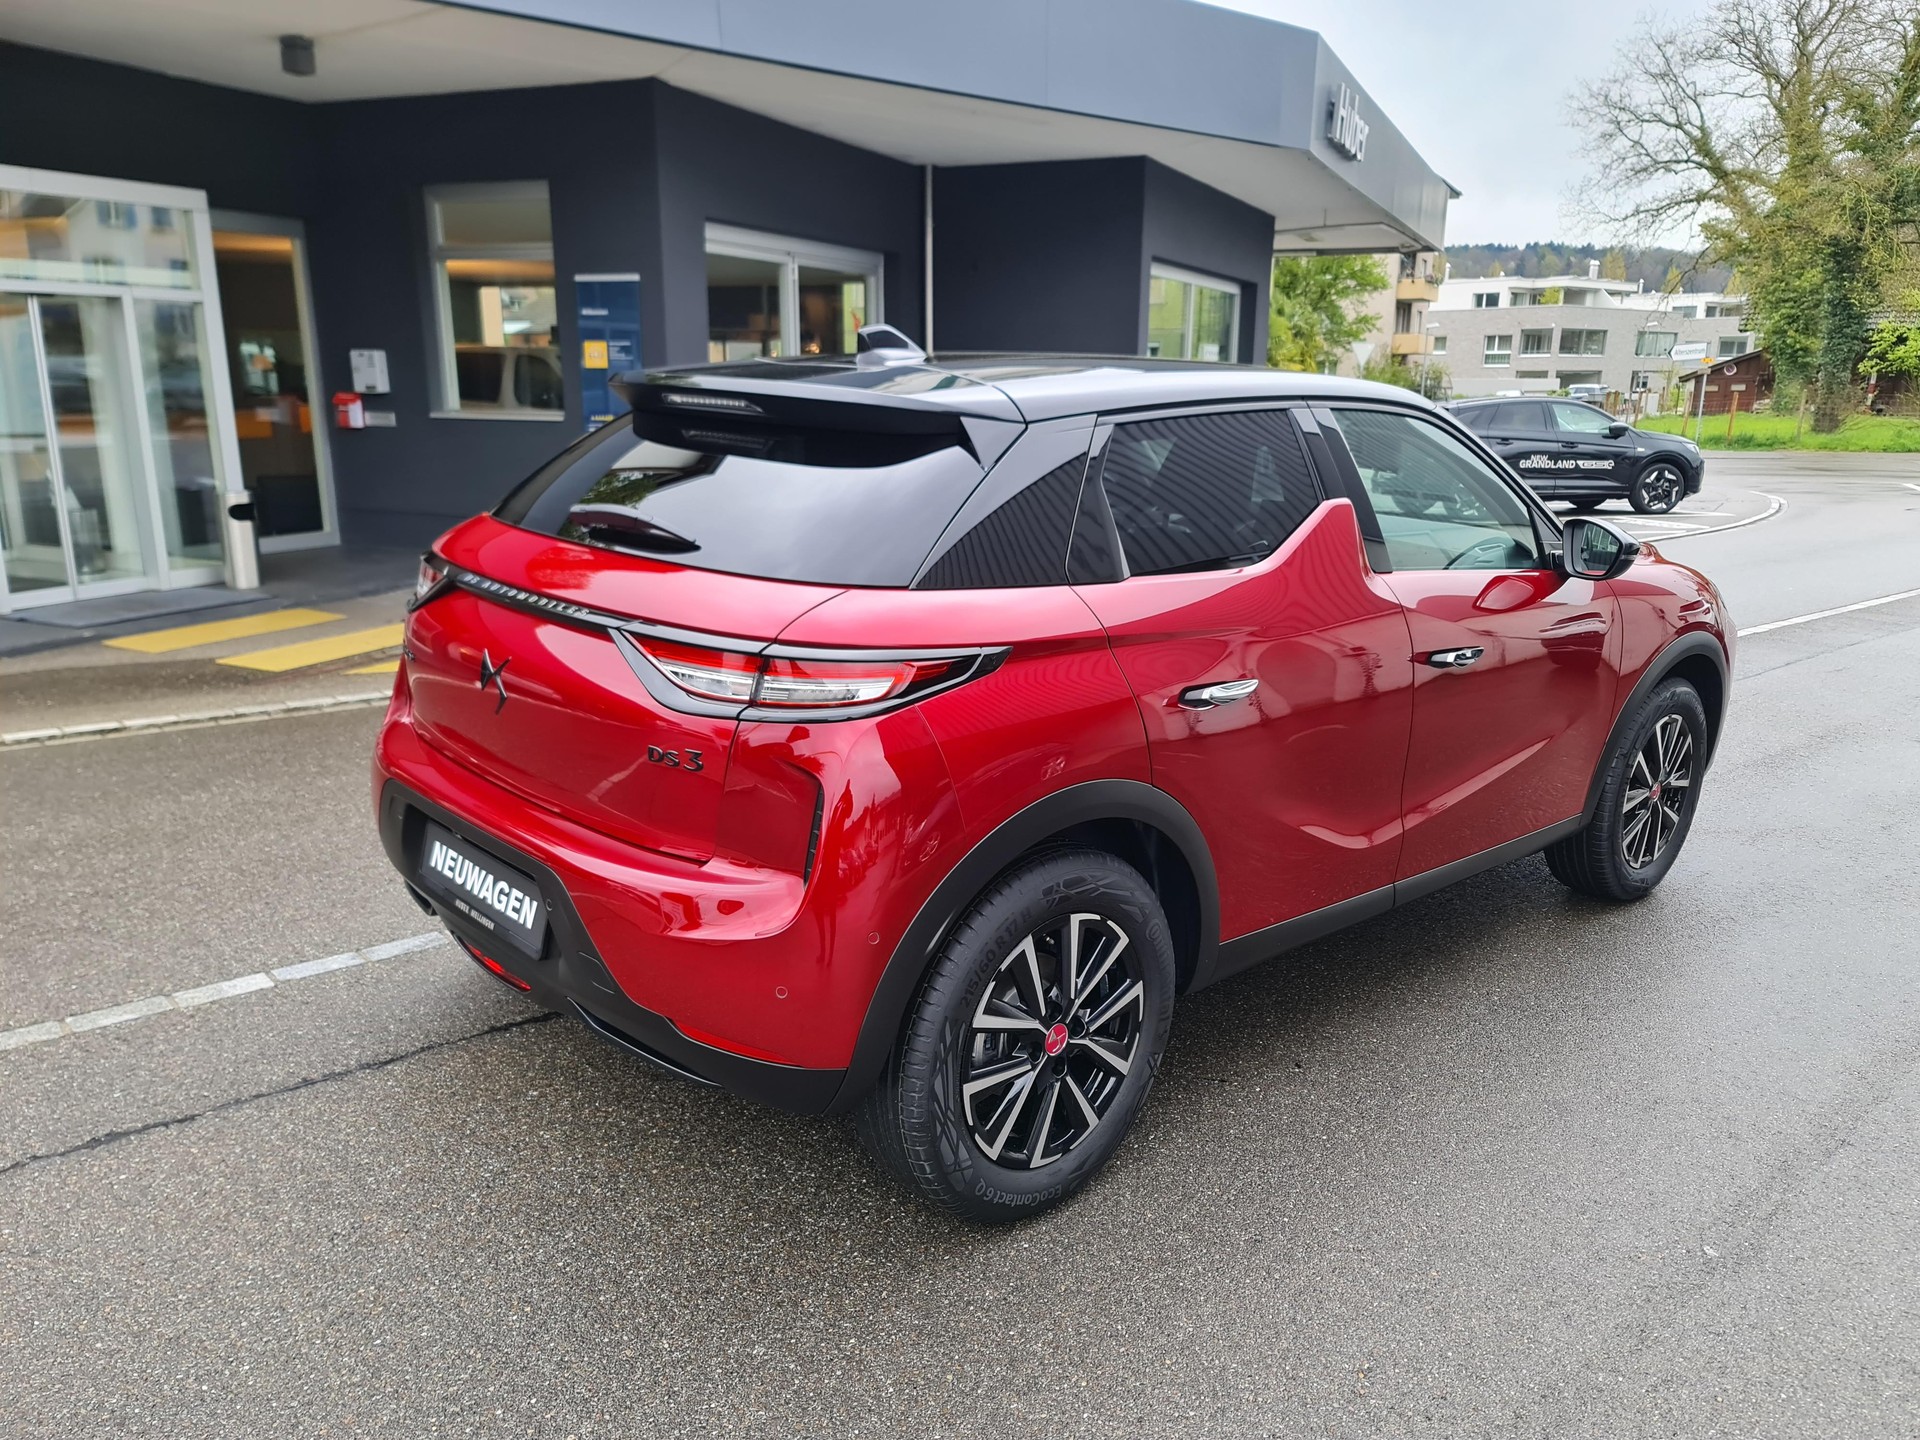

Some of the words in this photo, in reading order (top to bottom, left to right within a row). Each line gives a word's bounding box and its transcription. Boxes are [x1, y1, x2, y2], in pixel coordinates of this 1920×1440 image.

[1335, 81, 1370, 162] Huber
[1519, 459, 1576, 469] GRANDLAND
[481, 580, 590, 616] AUTOMOBILES
[648, 744, 680, 767] DS
[684, 748, 704, 772] 3
[430, 840, 538, 930] NEUWAGEN
[961, 949, 997, 1008] 215/60
[975, 1178, 986, 1196] Q
[983, 1187, 994, 1201] 6
[994, 1184, 1062, 1207] EcoContact
